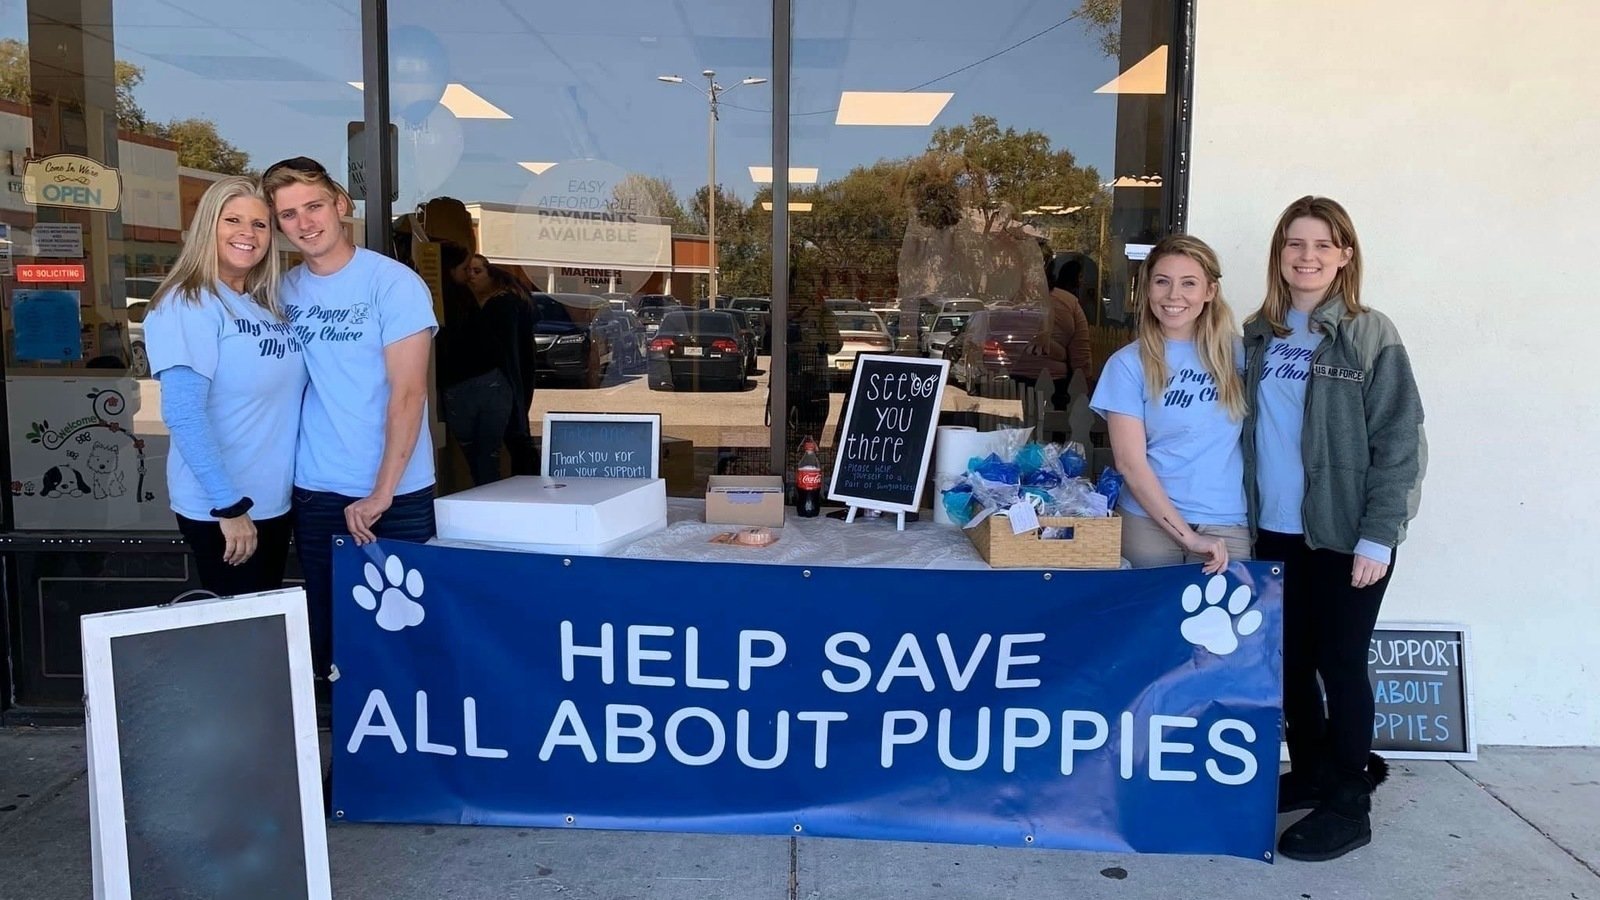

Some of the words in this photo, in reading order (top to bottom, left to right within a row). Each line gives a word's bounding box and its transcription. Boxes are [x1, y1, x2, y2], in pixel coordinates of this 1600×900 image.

[43, 184, 102, 205] OPEN
[538, 196, 637, 211] AFFORDABLE
[538, 210, 638, 225] PAYMENTS
[538, 226, 638, 242] AVAILABLE
[22, 269, 33, 278] NO
[36, 269, 80, 278] SOLICITING
[561, 267, 622, 278] MARINER
[583, 276, 622, 285] FINANE
[306, 304, 350, 324] Puppy
[234, 318, 261, 337] My
[260, 319, 291, 336] Pupp
[320, 325, 364, 342] Choice
[259, 337, 286, 360] My
[1327, 367, 1338, 377] AIR
[1339, 369, 1364, 380] FORCE
[1163, 389, 1195, 409] My
[847, 433, 904, 463] there
[560, 620, 787, 691] HELP
[821, 631, 1046, 693] SAVE
[1368, 638, 1461, 667] SUPPORT
[1374, 680, 1443, 705] ABOUT
[346, 688, 509, 759] ALL
[538, 699, 849, 770] ABOUT
[880, 706, 1258, 785] PUPPIES
[1373, 712, 1450, 742] PPIES
